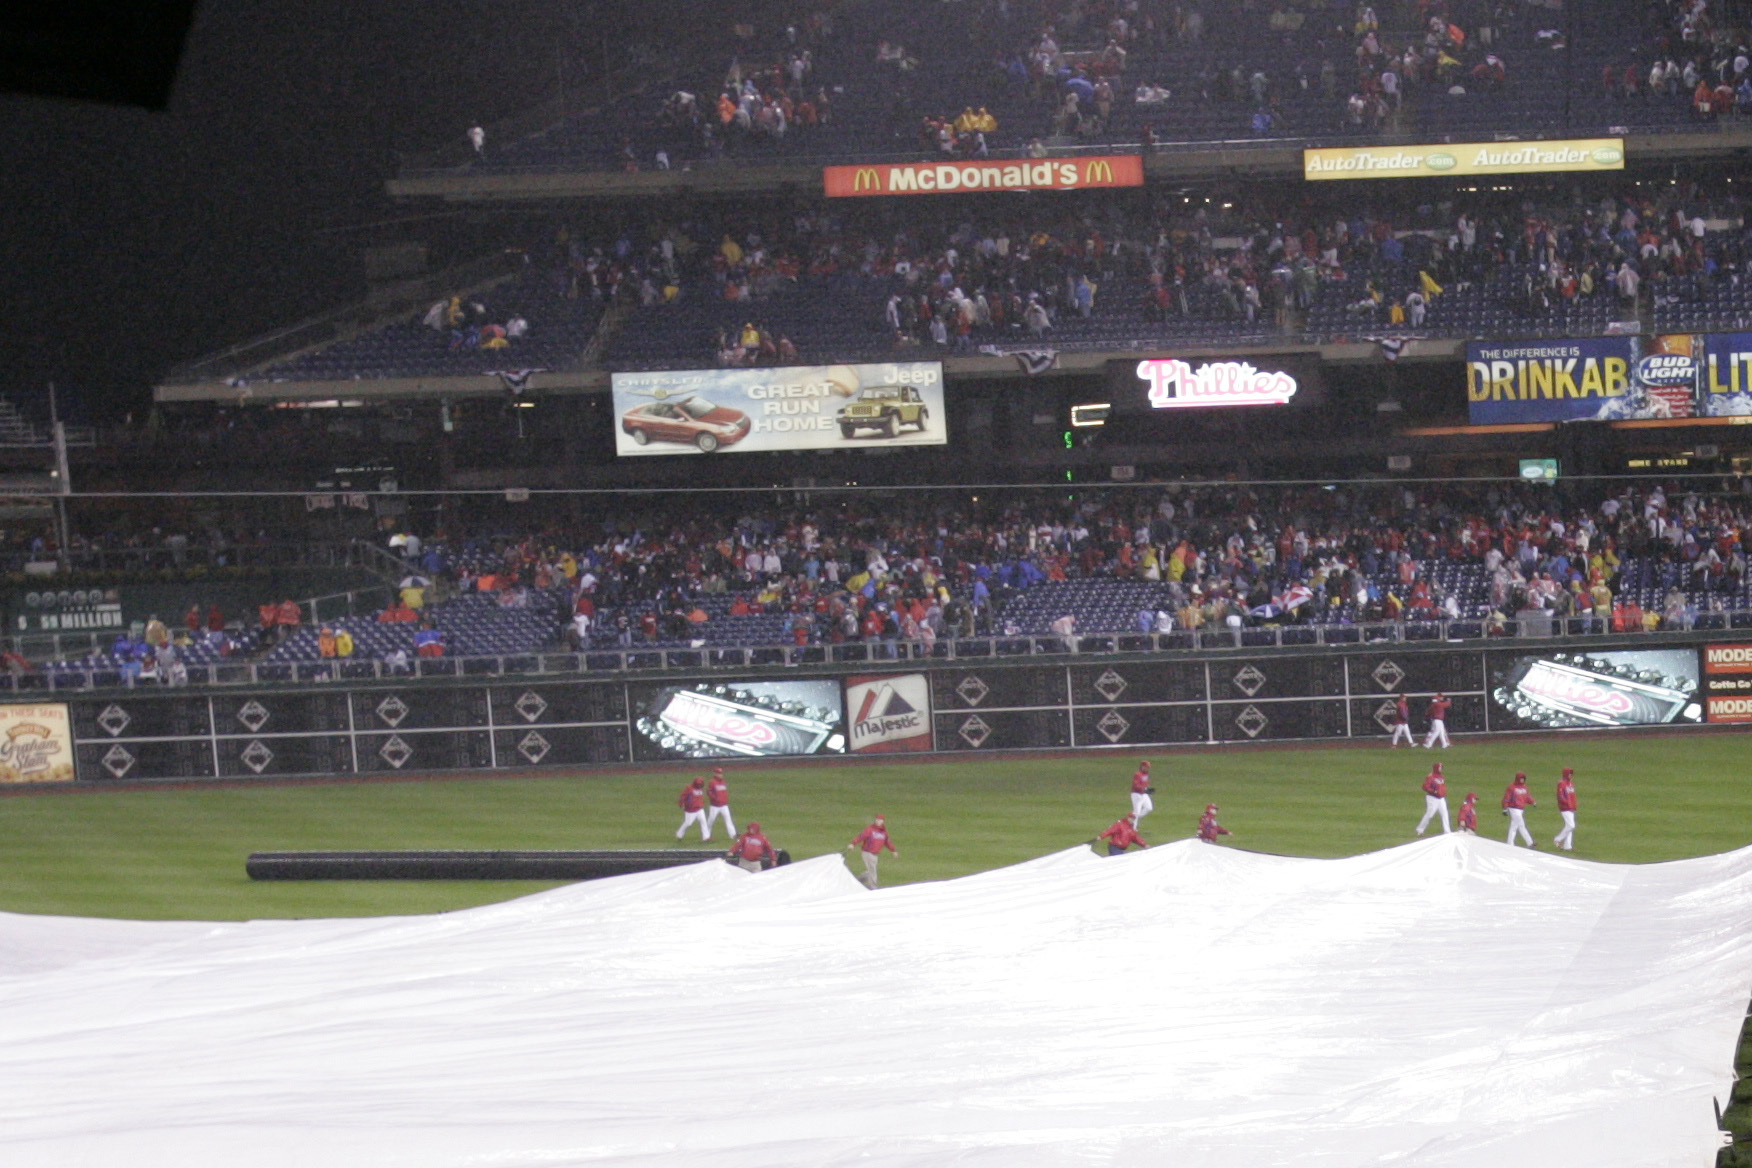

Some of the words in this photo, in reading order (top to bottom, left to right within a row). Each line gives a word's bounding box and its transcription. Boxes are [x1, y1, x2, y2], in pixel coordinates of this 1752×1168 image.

[1307, 153, 1424, 172] AutoTrader
[1472, 147, 1589, 167] AutoTrader
[888, 162, 1079, 191] McDonald's
[1480, 350, 1500, 360] THE
[1502, 347, 1568, 359] DIFFERENCE
[1569, 346, 1580, 357] IS
[1650, 357, 1691, 368] BUD
[884, 366, 938, 387] Jeep
[1467, 356, 1629, 402] DRINKAB
[1643, 368, 1695, 379] LIGHT
[747, 382, 834, 400] GREAT
[1137, 359, 1297, 408] Phillies
[763, 400, 820, 416] RUN
[754, 416, 834, 433] HOME
[61, 611, 123, 629] MILLION
[1709, 680, 1736, 690] Gotta
[1737, 679, 1751, 689] Go
